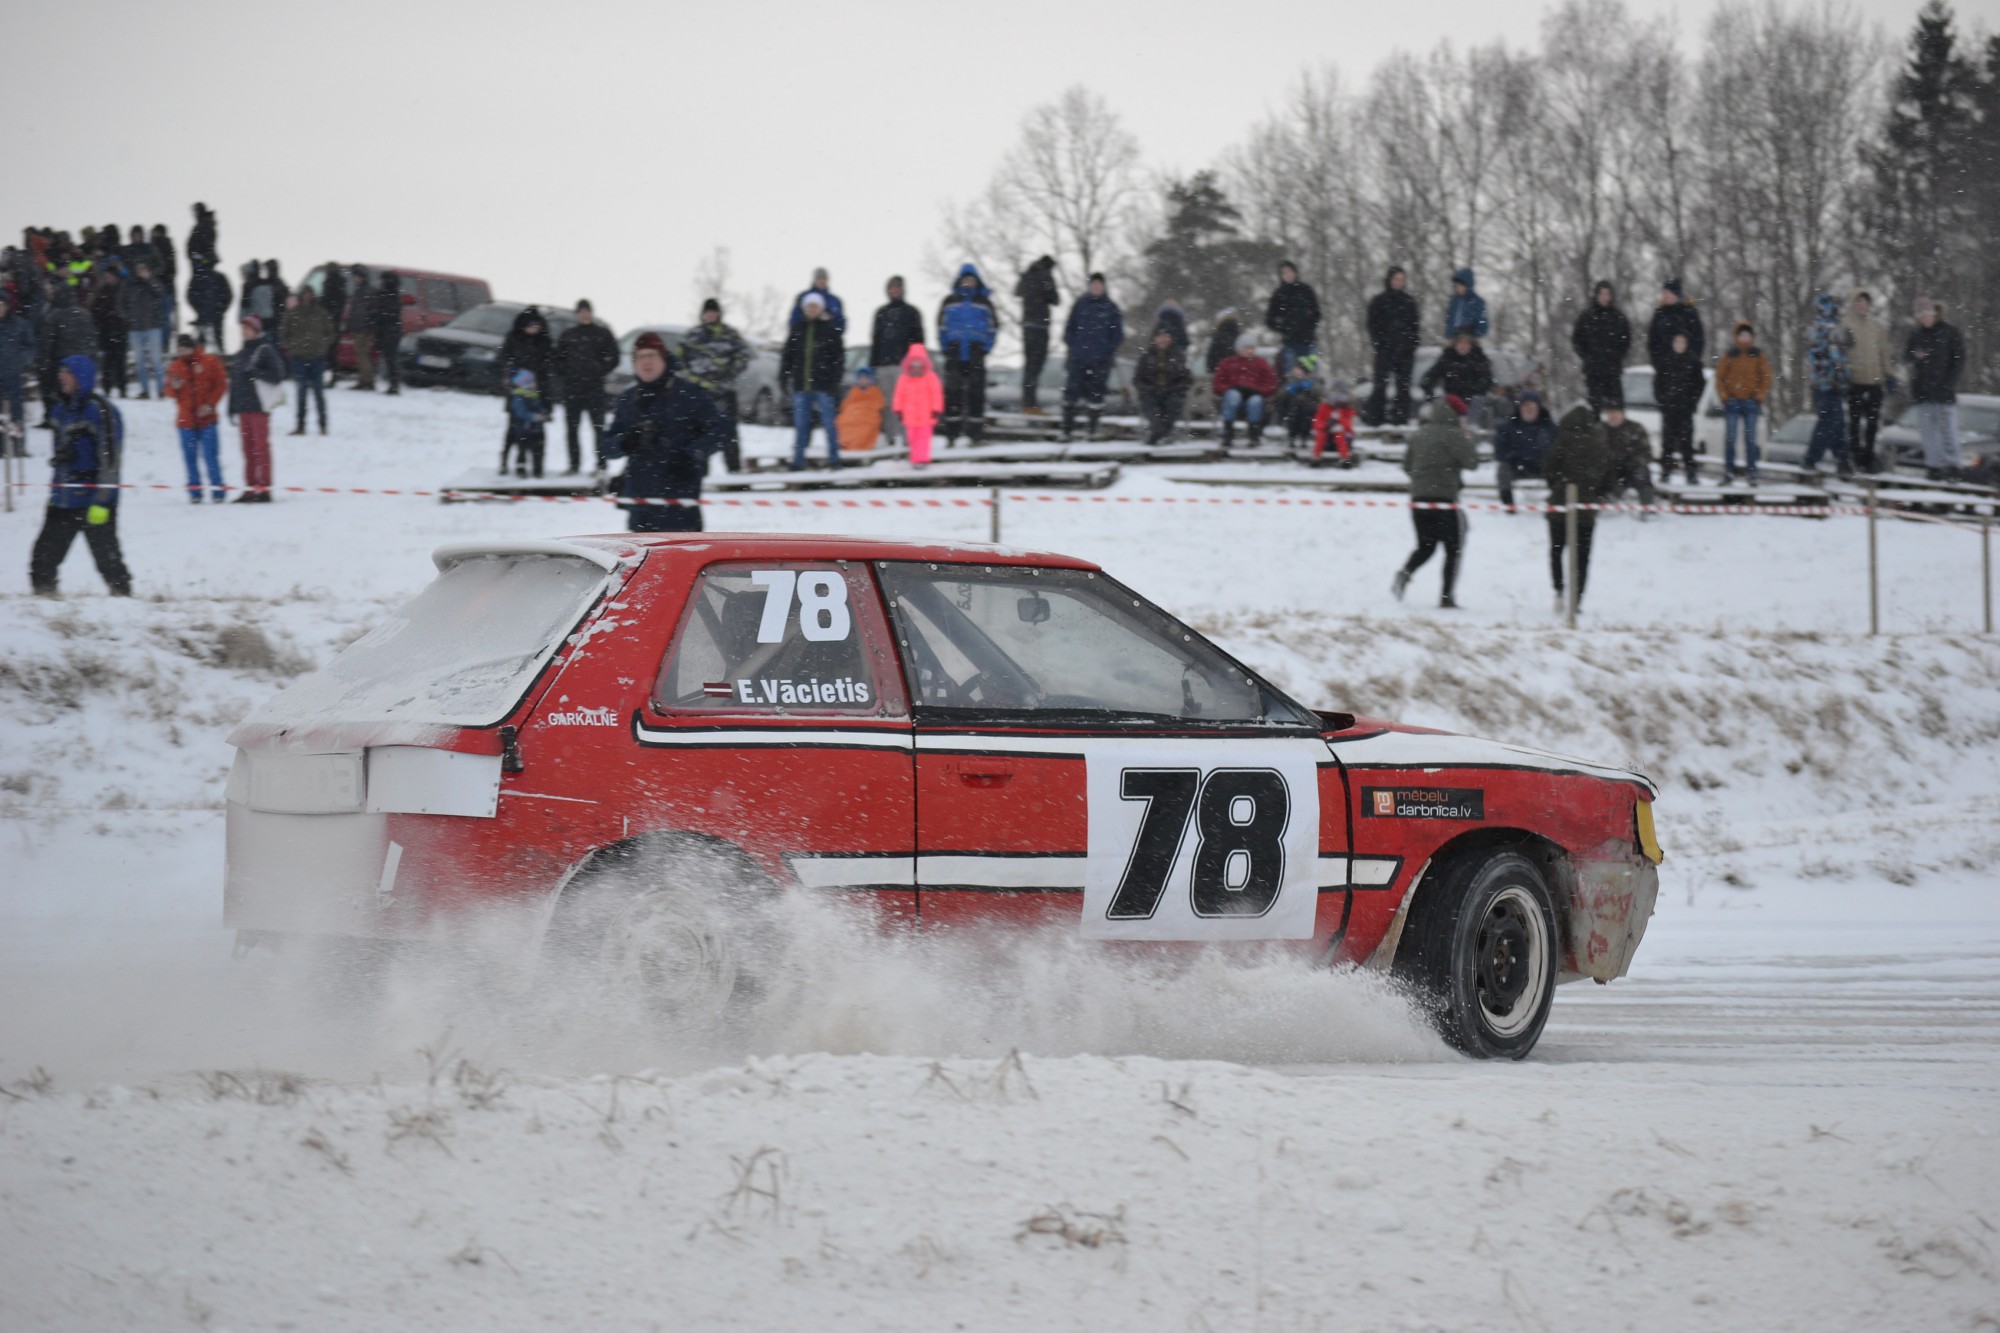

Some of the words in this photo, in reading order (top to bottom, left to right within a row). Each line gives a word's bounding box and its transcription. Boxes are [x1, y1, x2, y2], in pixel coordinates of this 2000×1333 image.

[751, 570, 850, 643] 78
[737, 677, 869, 704] E.Vācietis
[1397, 804, 1471, 817] darbnīca.lv
[1106, 767, 1291, 920] 78
